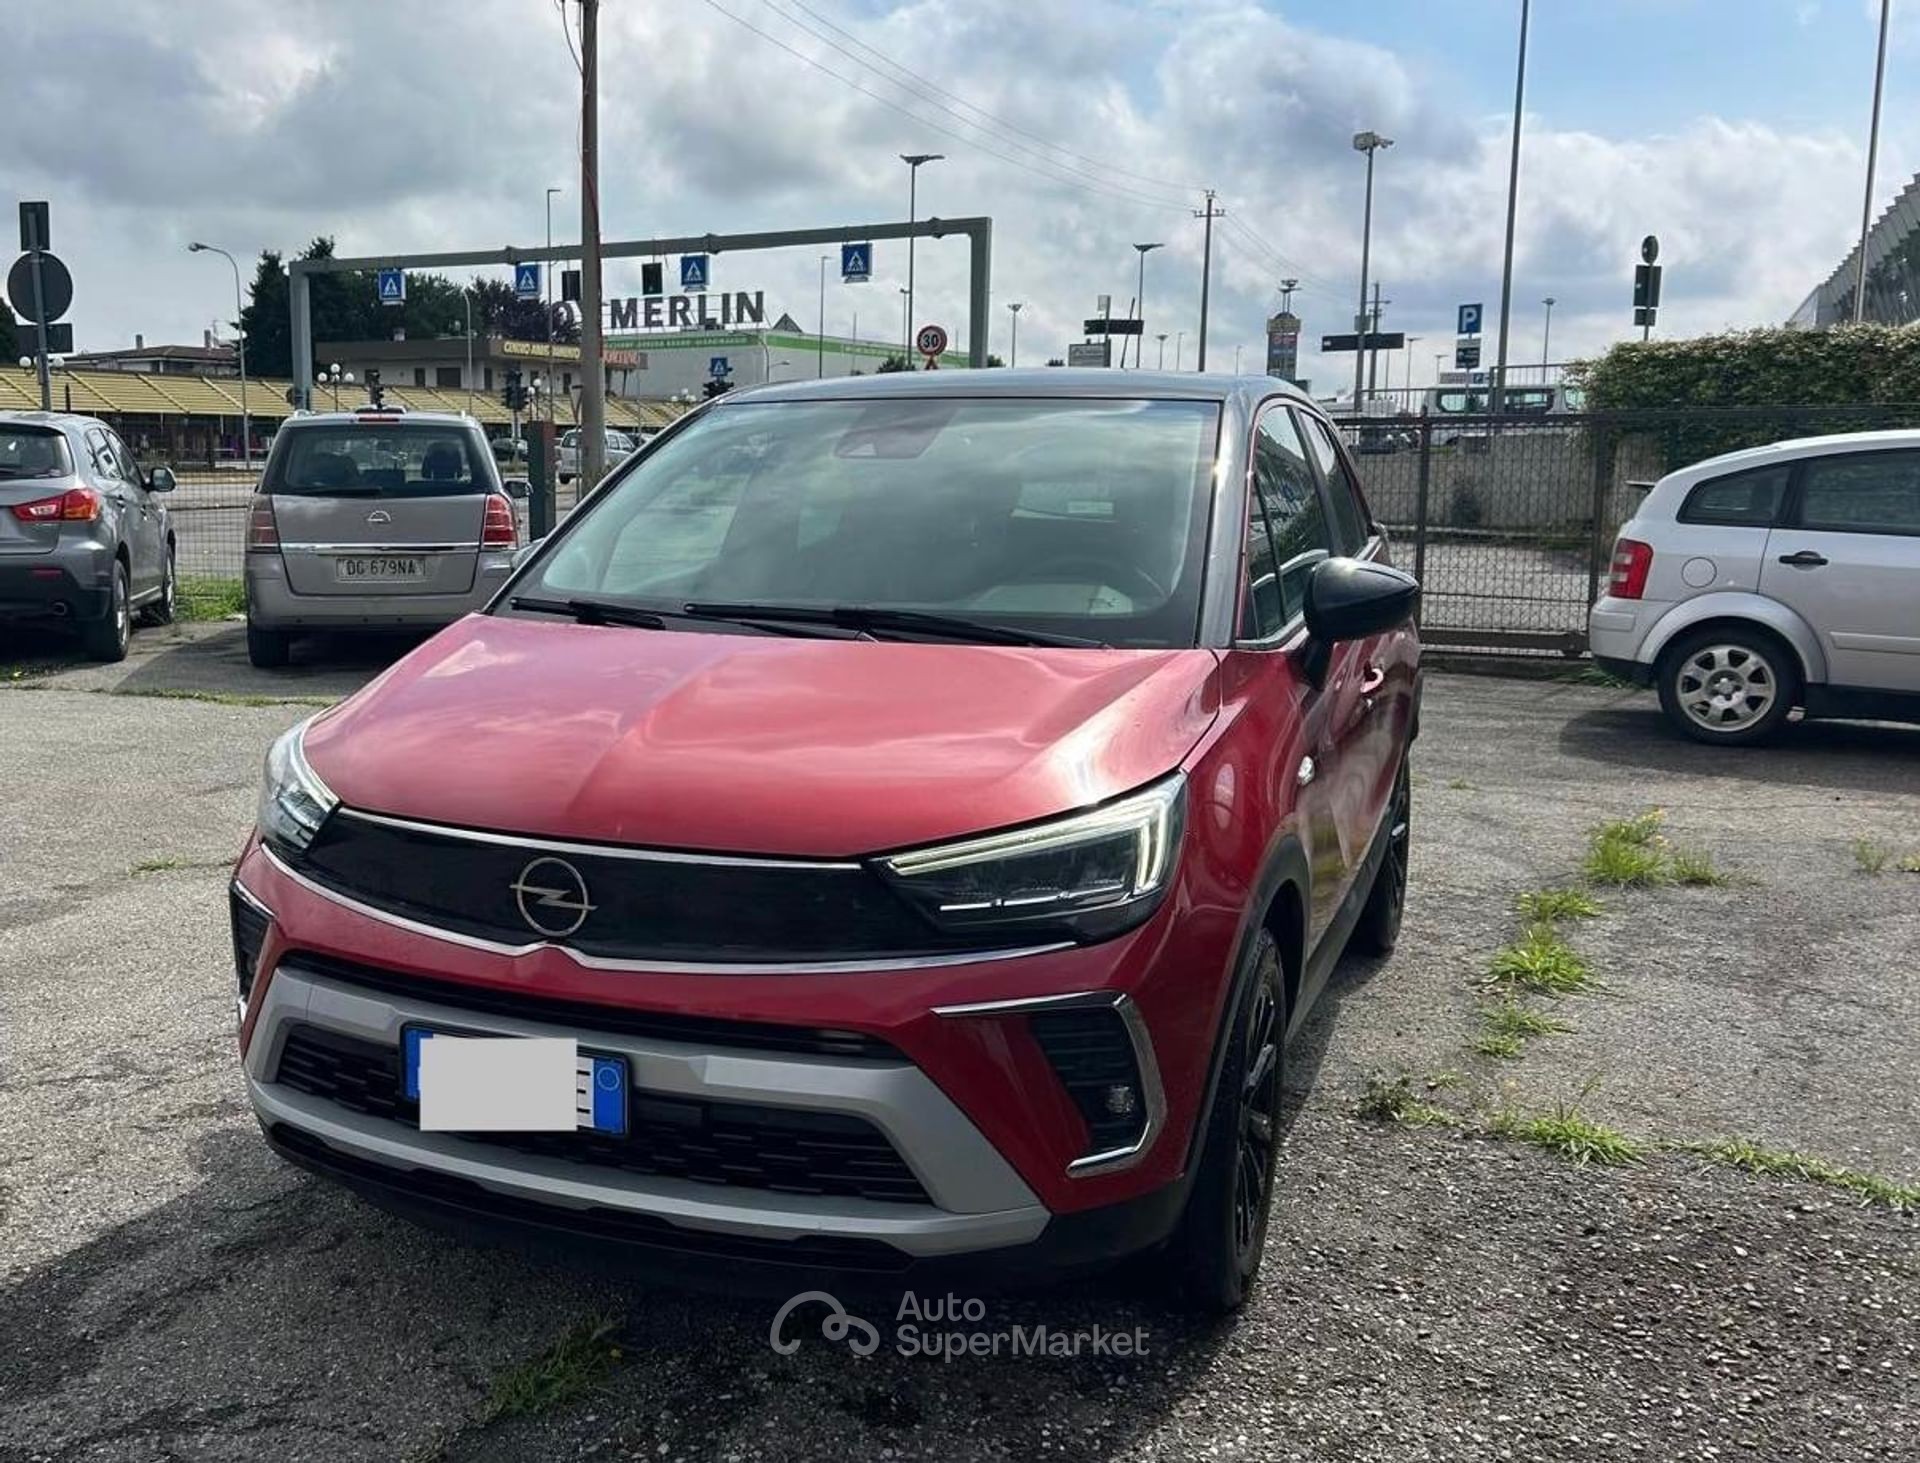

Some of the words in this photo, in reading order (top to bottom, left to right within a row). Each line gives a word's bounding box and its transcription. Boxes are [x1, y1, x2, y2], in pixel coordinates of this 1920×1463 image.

[610, 291, 764, 329] MERLIN
[1462, 307, 1477, 332] P
[923, 334, 939, 348] 30
